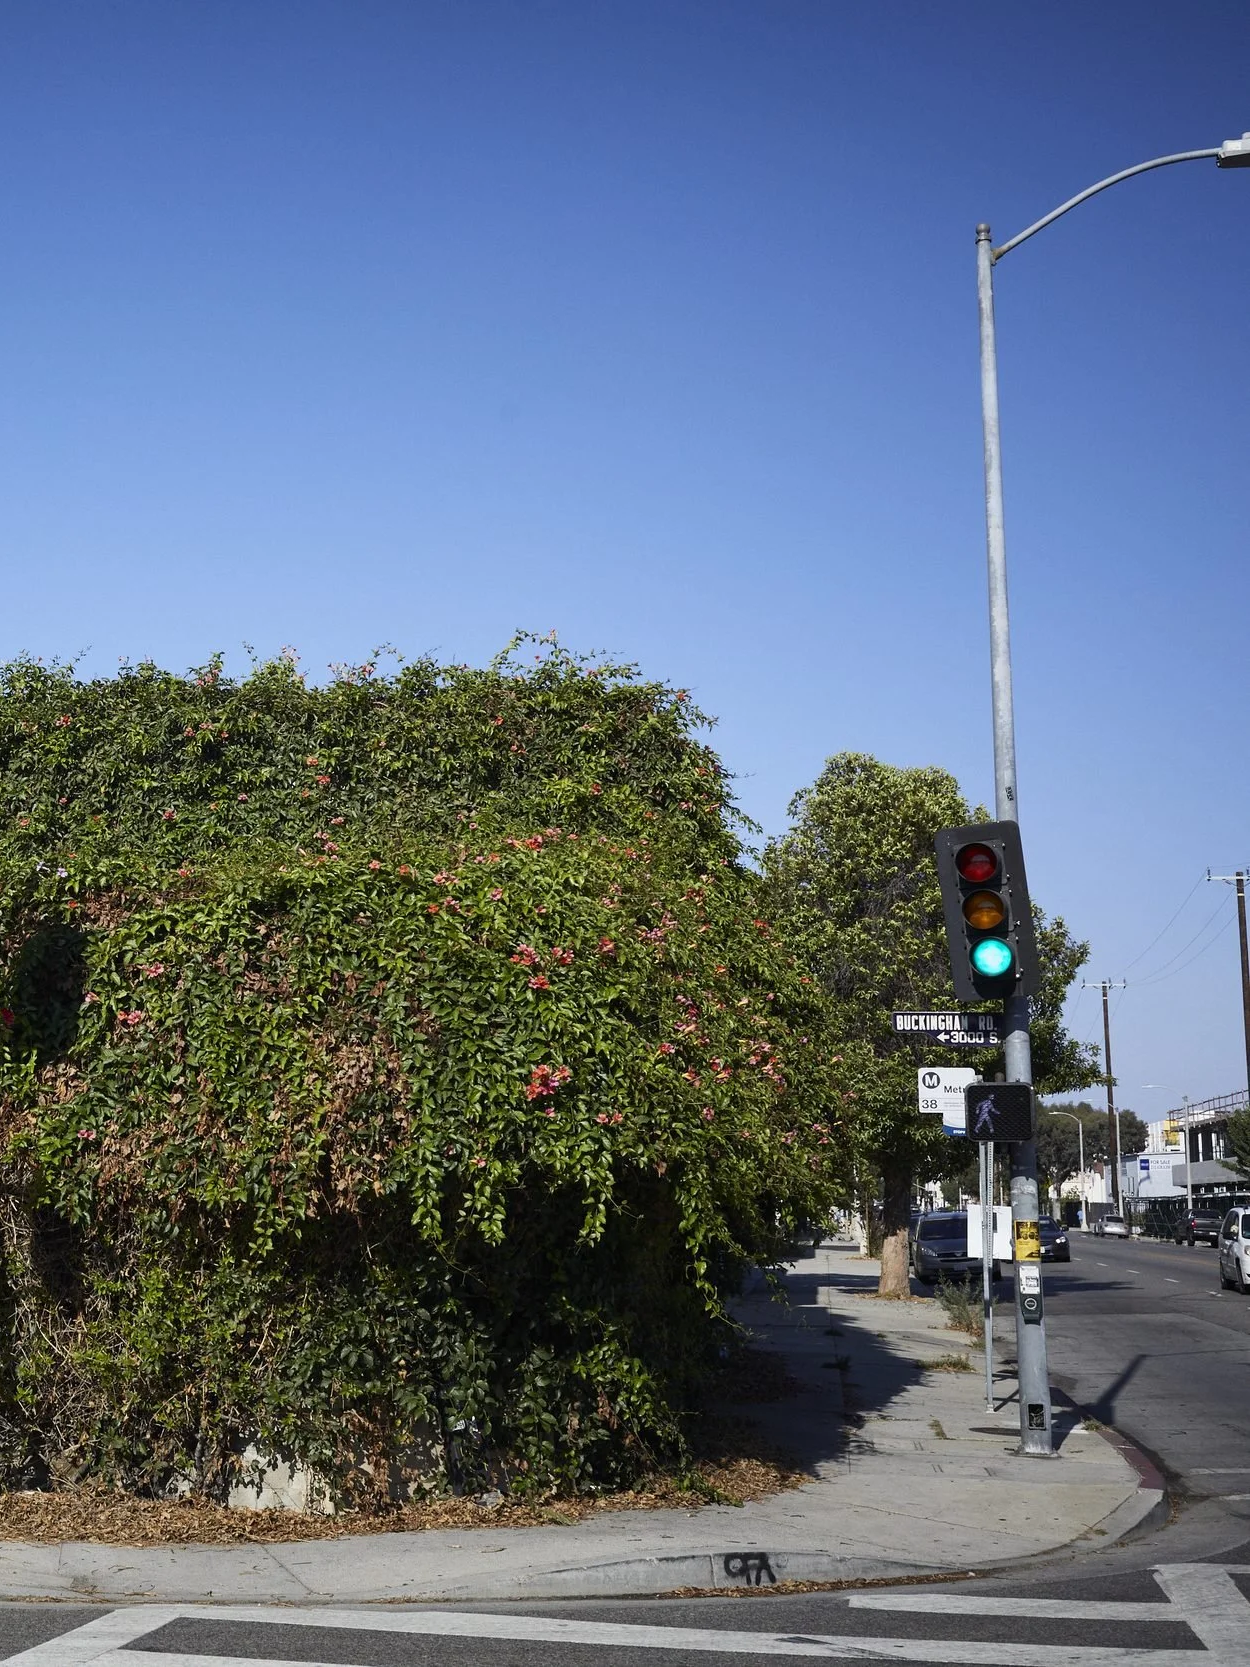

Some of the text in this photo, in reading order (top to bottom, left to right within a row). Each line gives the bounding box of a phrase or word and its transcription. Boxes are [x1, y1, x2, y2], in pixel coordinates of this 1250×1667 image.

[896, 1015, 998, 1031] BUCKINGHAM RD.
[950, 1031, 1002, 1044] 3000 S.
[943, 1085, 966, 1094] Metr
[921, 1099, 938, 1109] 38
